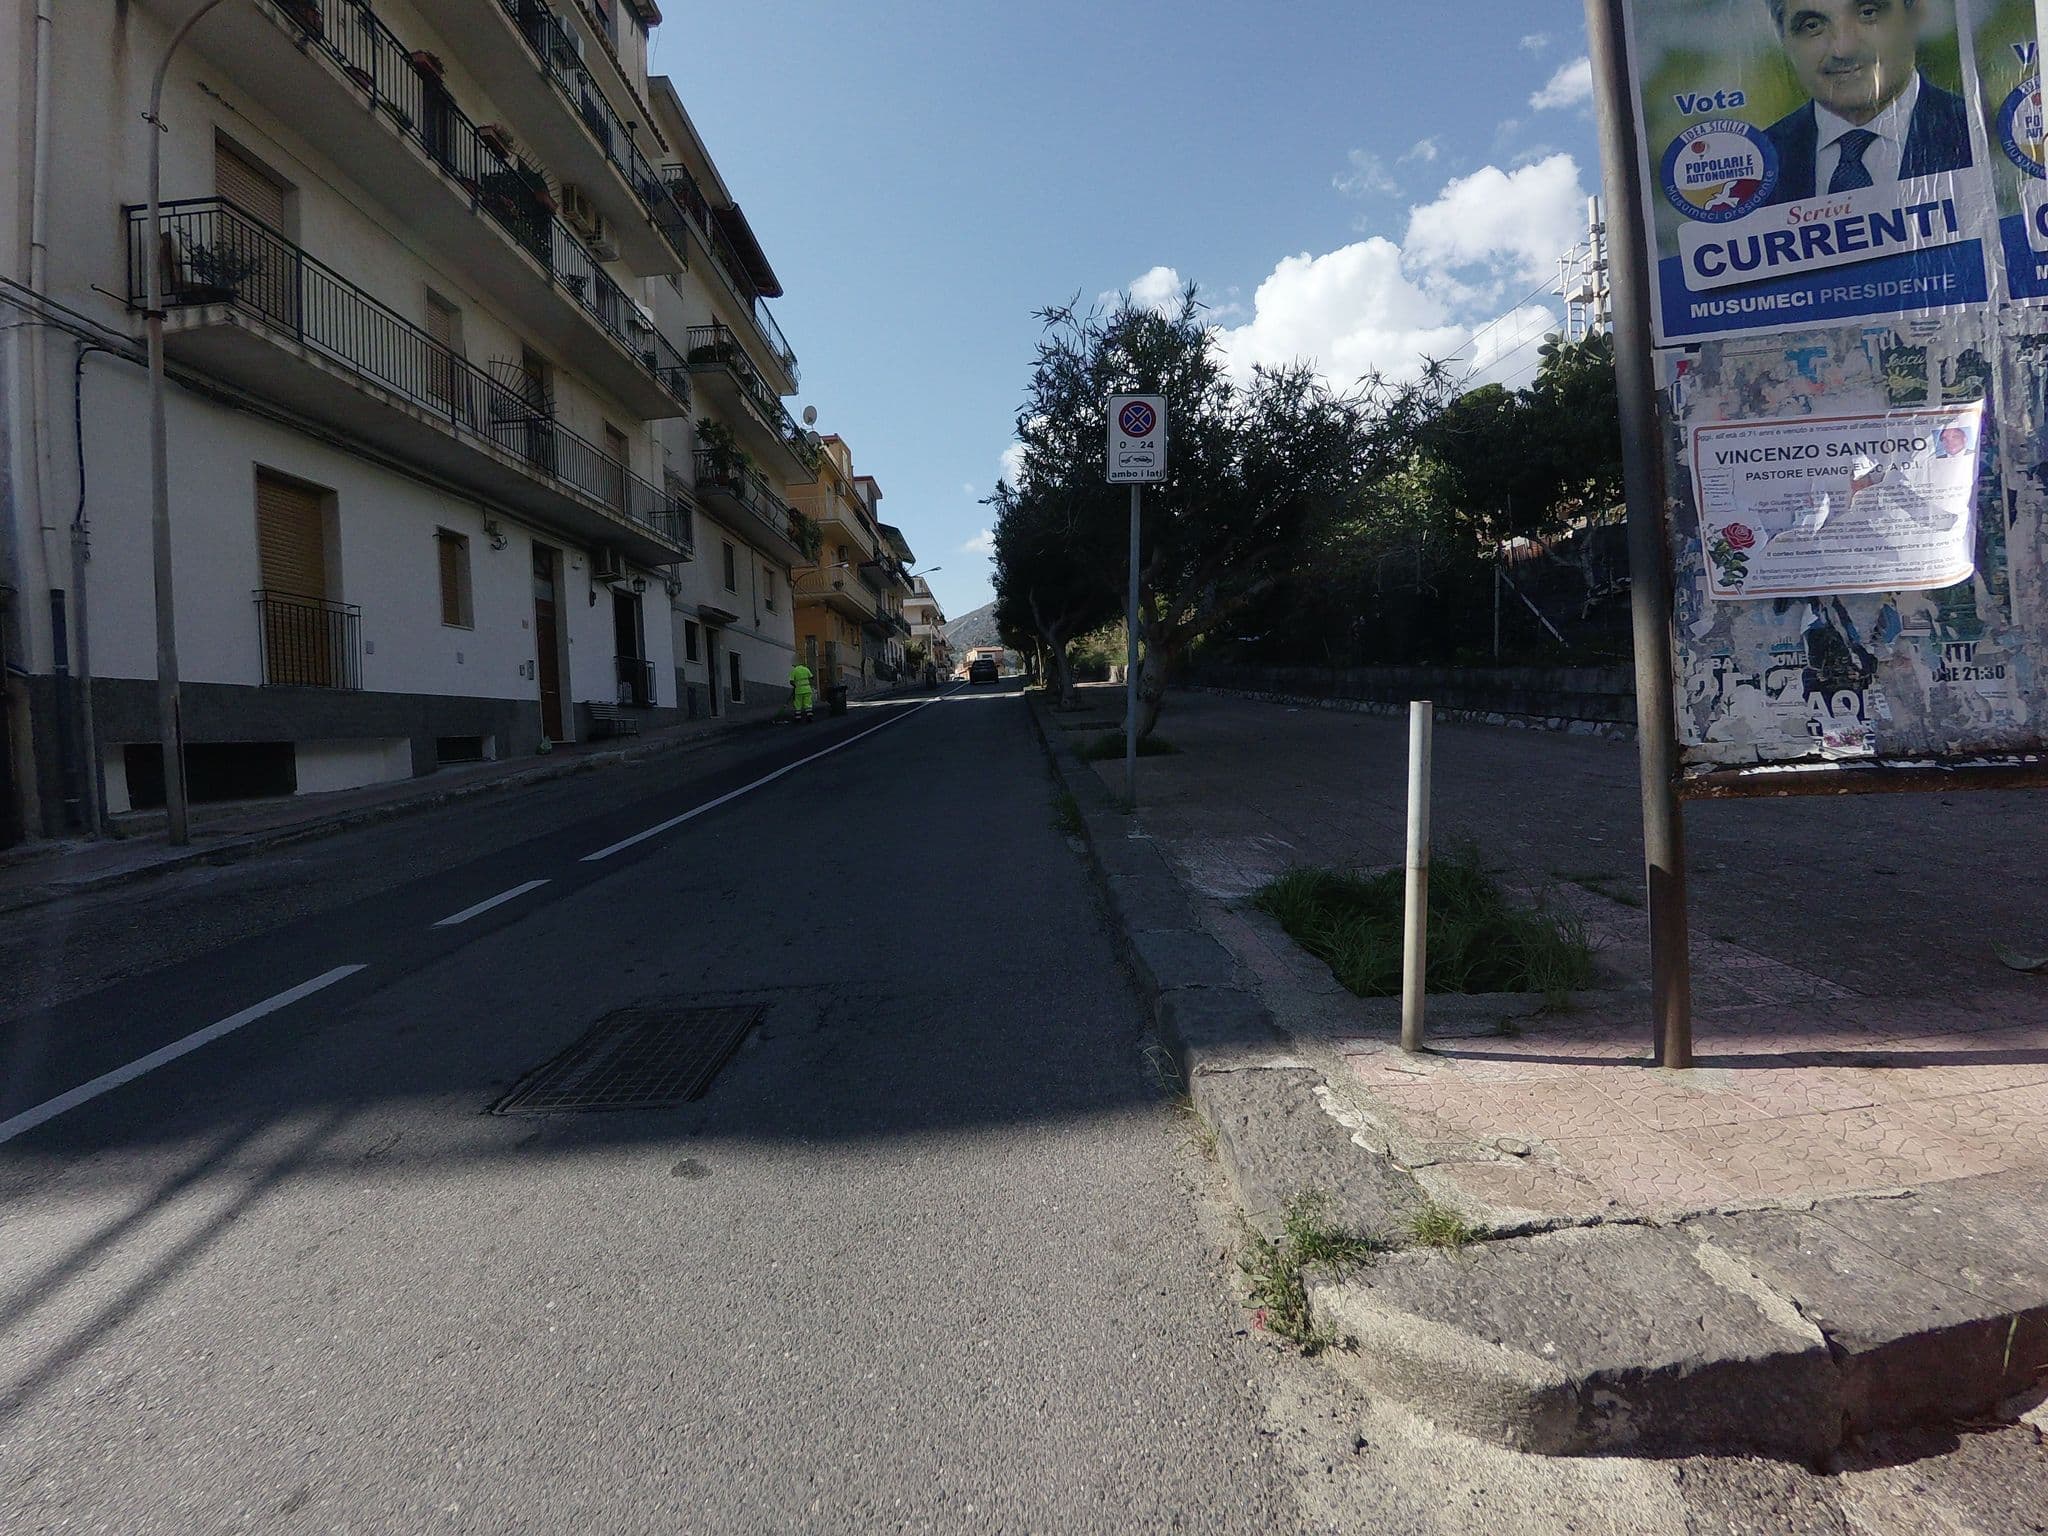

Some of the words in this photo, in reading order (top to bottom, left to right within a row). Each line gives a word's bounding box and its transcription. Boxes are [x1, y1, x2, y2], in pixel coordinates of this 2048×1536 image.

[1674, 89, 1745, 115] Vota
[1684, 125, 1706, 141] IDEA
[1710, 120, 1745, 135] SICILIA
[1685, 155, 1744, 174] POPOLARI
[1746, 154, 1754, 166] E
[1686, 166, 1755, 185] AUTONOMISTI
[1666, 184, 1719, 220] Musumeci
[1787, 195, 1853, 226] Scrivi
[1692, 199, 1959, 279] CURRENTI
[1690, 291, 1814, 319] MUSUMECI
[1820, 273, 1957, 304] PRESIDENTE
[1119, 441, 1127, 449] 0
[1140, 441, 1154, 449] 24
[1715, 444, 1820, 465] VINCENZO
[1826, 437, 1927, 457] SANTORO
[1111, 470, 1138, 478] ambo
[1147, 470, 1162, 478] lati
[1746, 468, 1803, 481] PASTORE
[1963, 665, 2005, 681] 21:30
